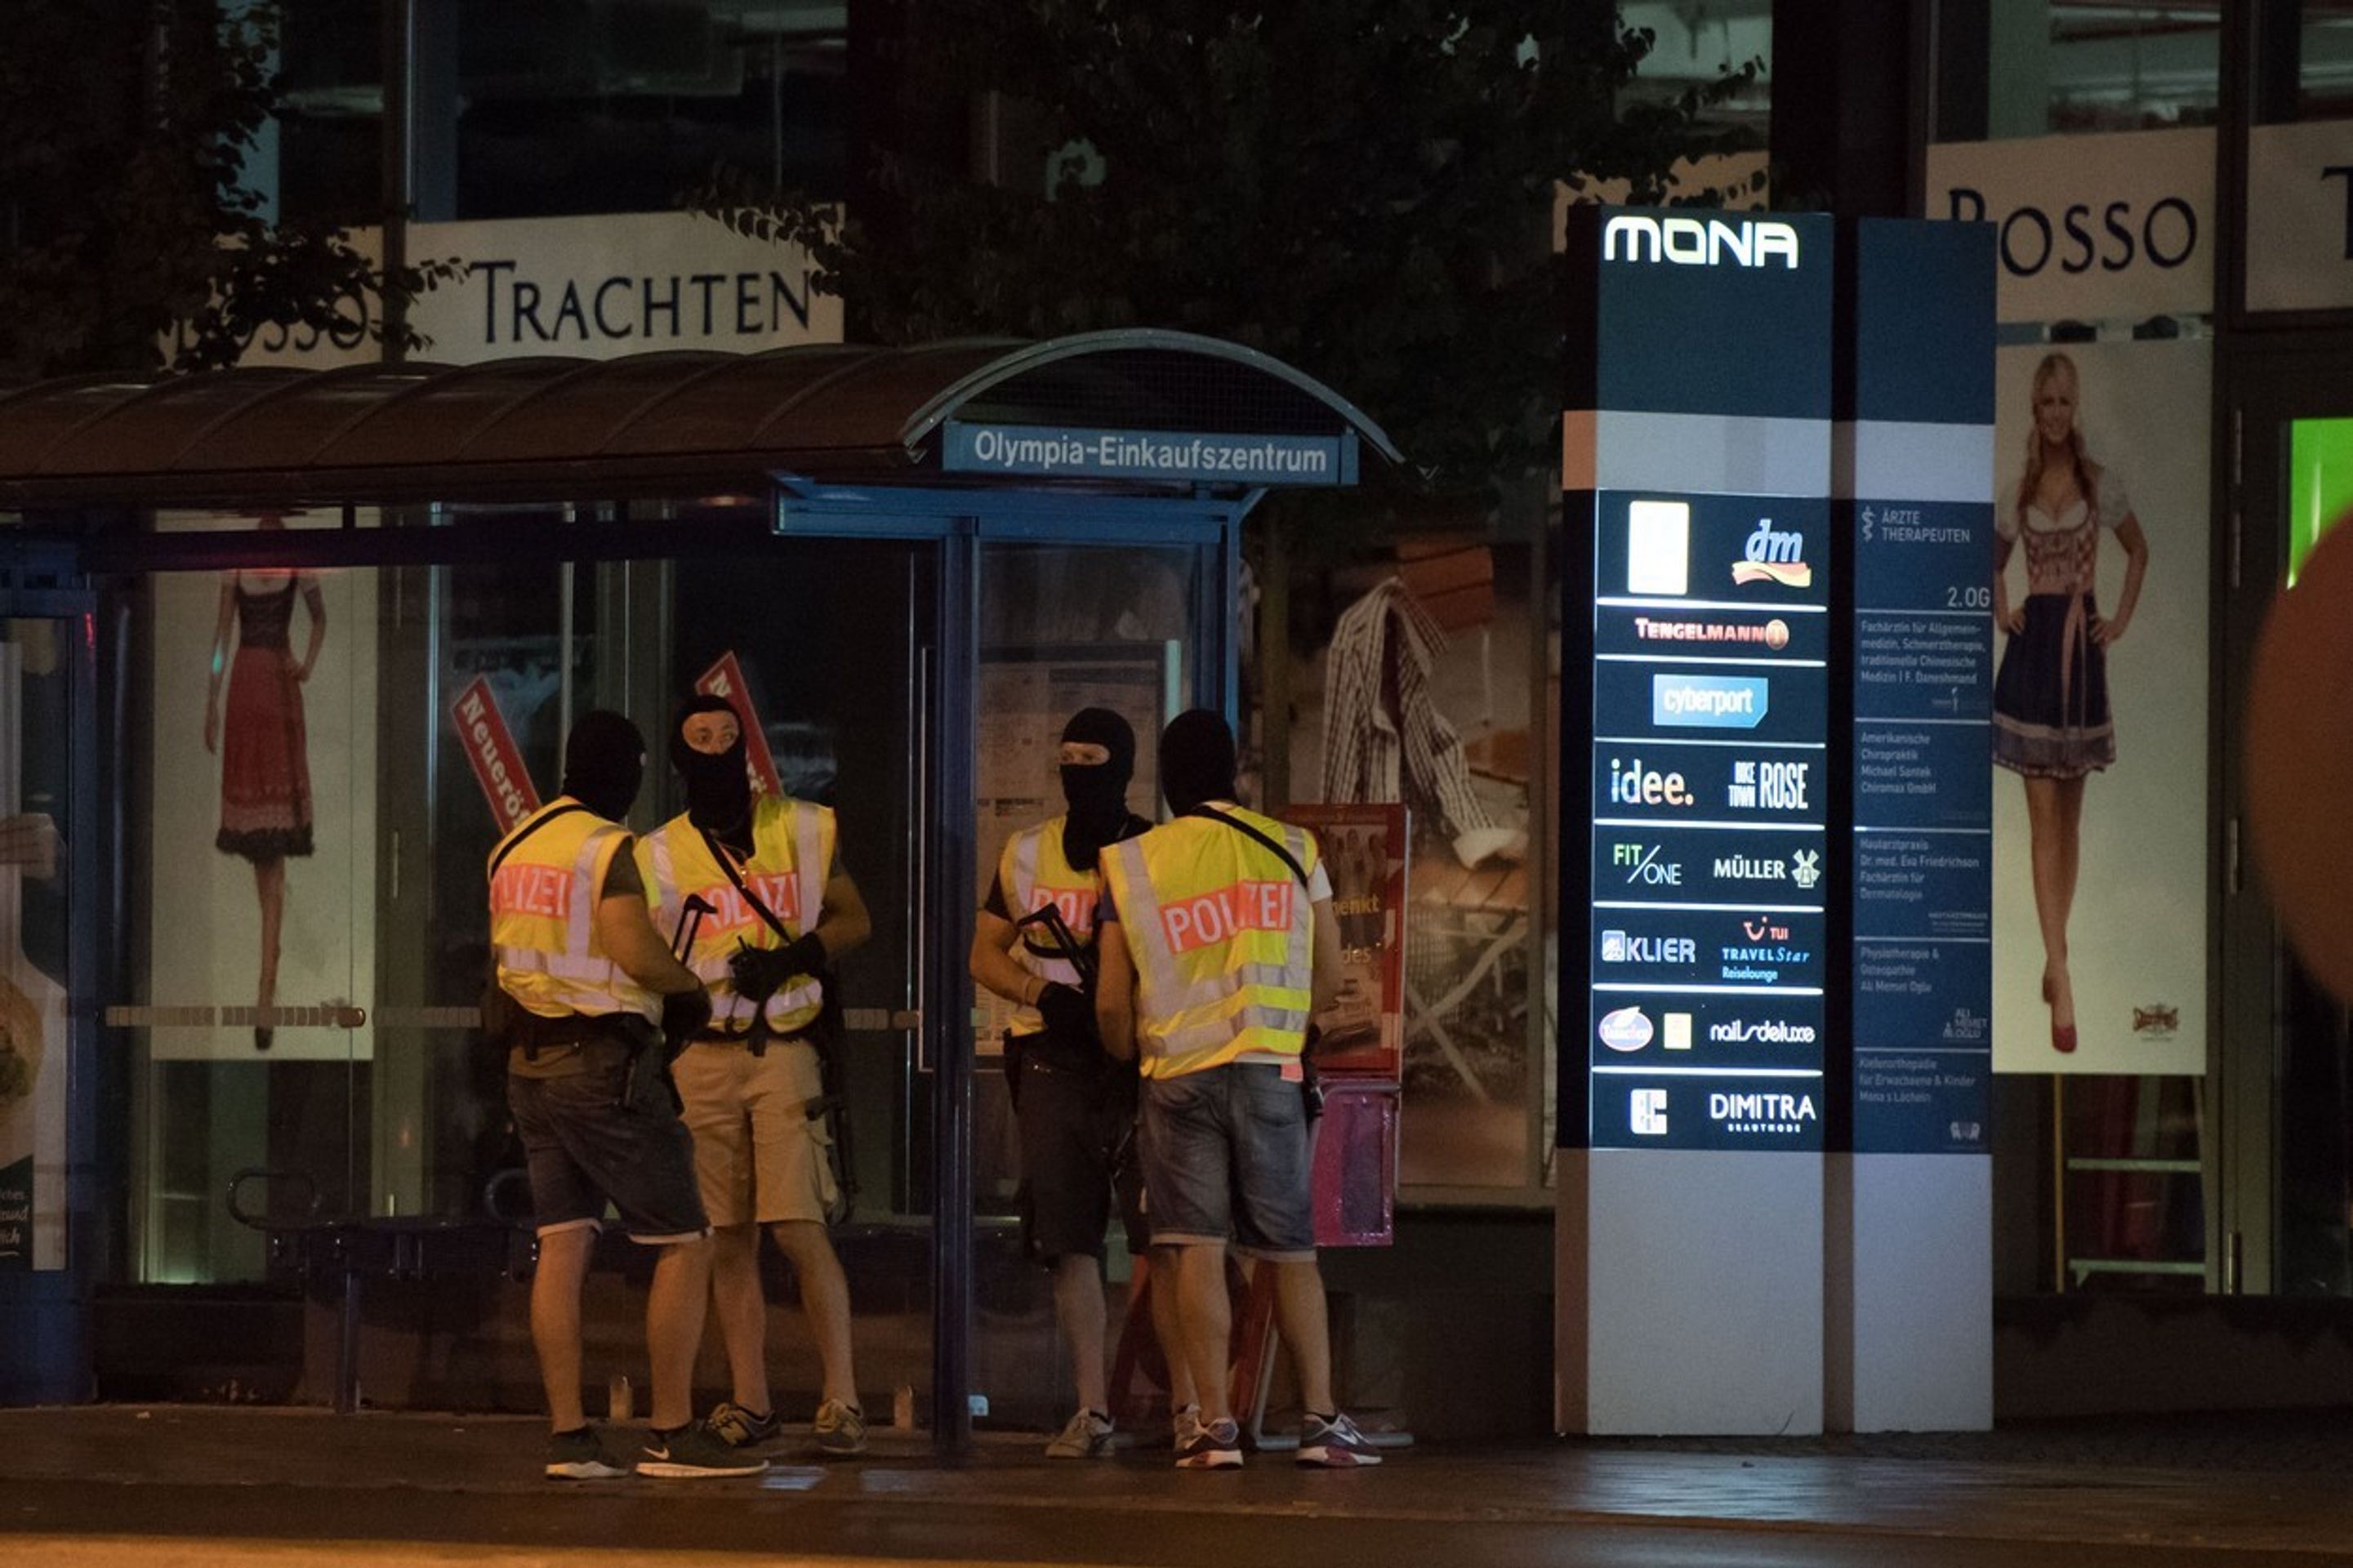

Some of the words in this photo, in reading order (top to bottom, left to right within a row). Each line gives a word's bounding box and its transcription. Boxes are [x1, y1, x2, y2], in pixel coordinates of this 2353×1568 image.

[1604, 216, 1798, 269] MONA
[469, 260, 810, 344] TRACHTEN
[974, 430, 1327, 473] Olympia-Einkaufszentrum
[1882, 506, 1920, 525] ÄRZTE
[1745, 518, 1803, 563] dm
[1882, 527, 1970, 543] THERAPEUTEN
[1635, 617, 1765, 643] TENGELMANN
[1663, 686, 1754, 716] cyberport
[1760, 761, 1808, 810] ROSE
[1714, 854, 1786, 880] MÜLLER
[1770, 928, 1789, 939] TUI
[1627, 937, 1696, 963] KLIER
[1722, 966, 1778, 983] Reiselounge
[1710, 1094, 1816, 1120] DIMITRA
